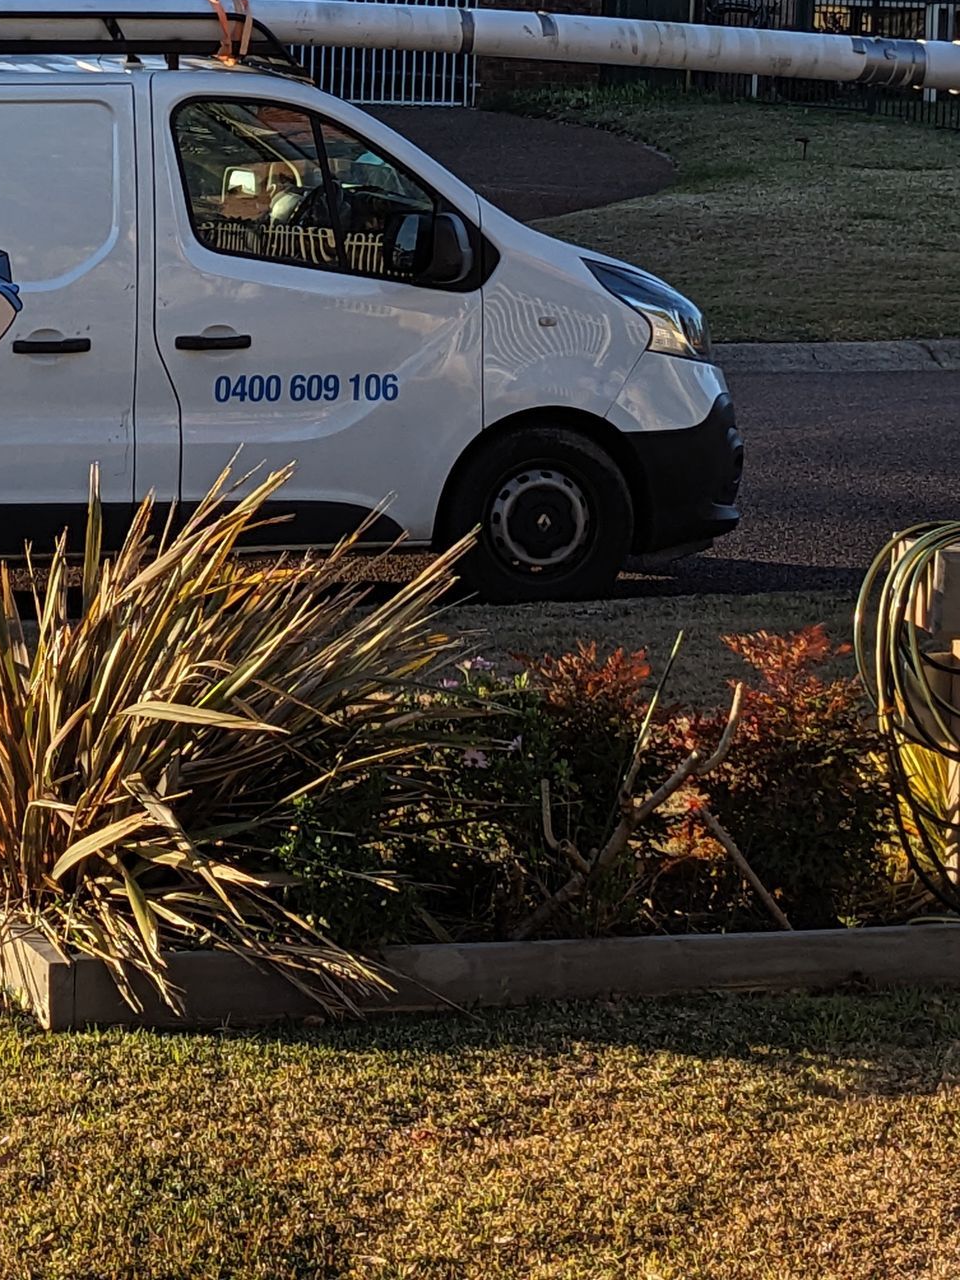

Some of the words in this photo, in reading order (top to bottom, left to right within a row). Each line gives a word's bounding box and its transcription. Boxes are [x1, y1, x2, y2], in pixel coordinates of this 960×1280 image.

[214, 374, 281, 402] 0400
[290, 374, 340, 401] 609
[348, 373, 399, 401] 106
